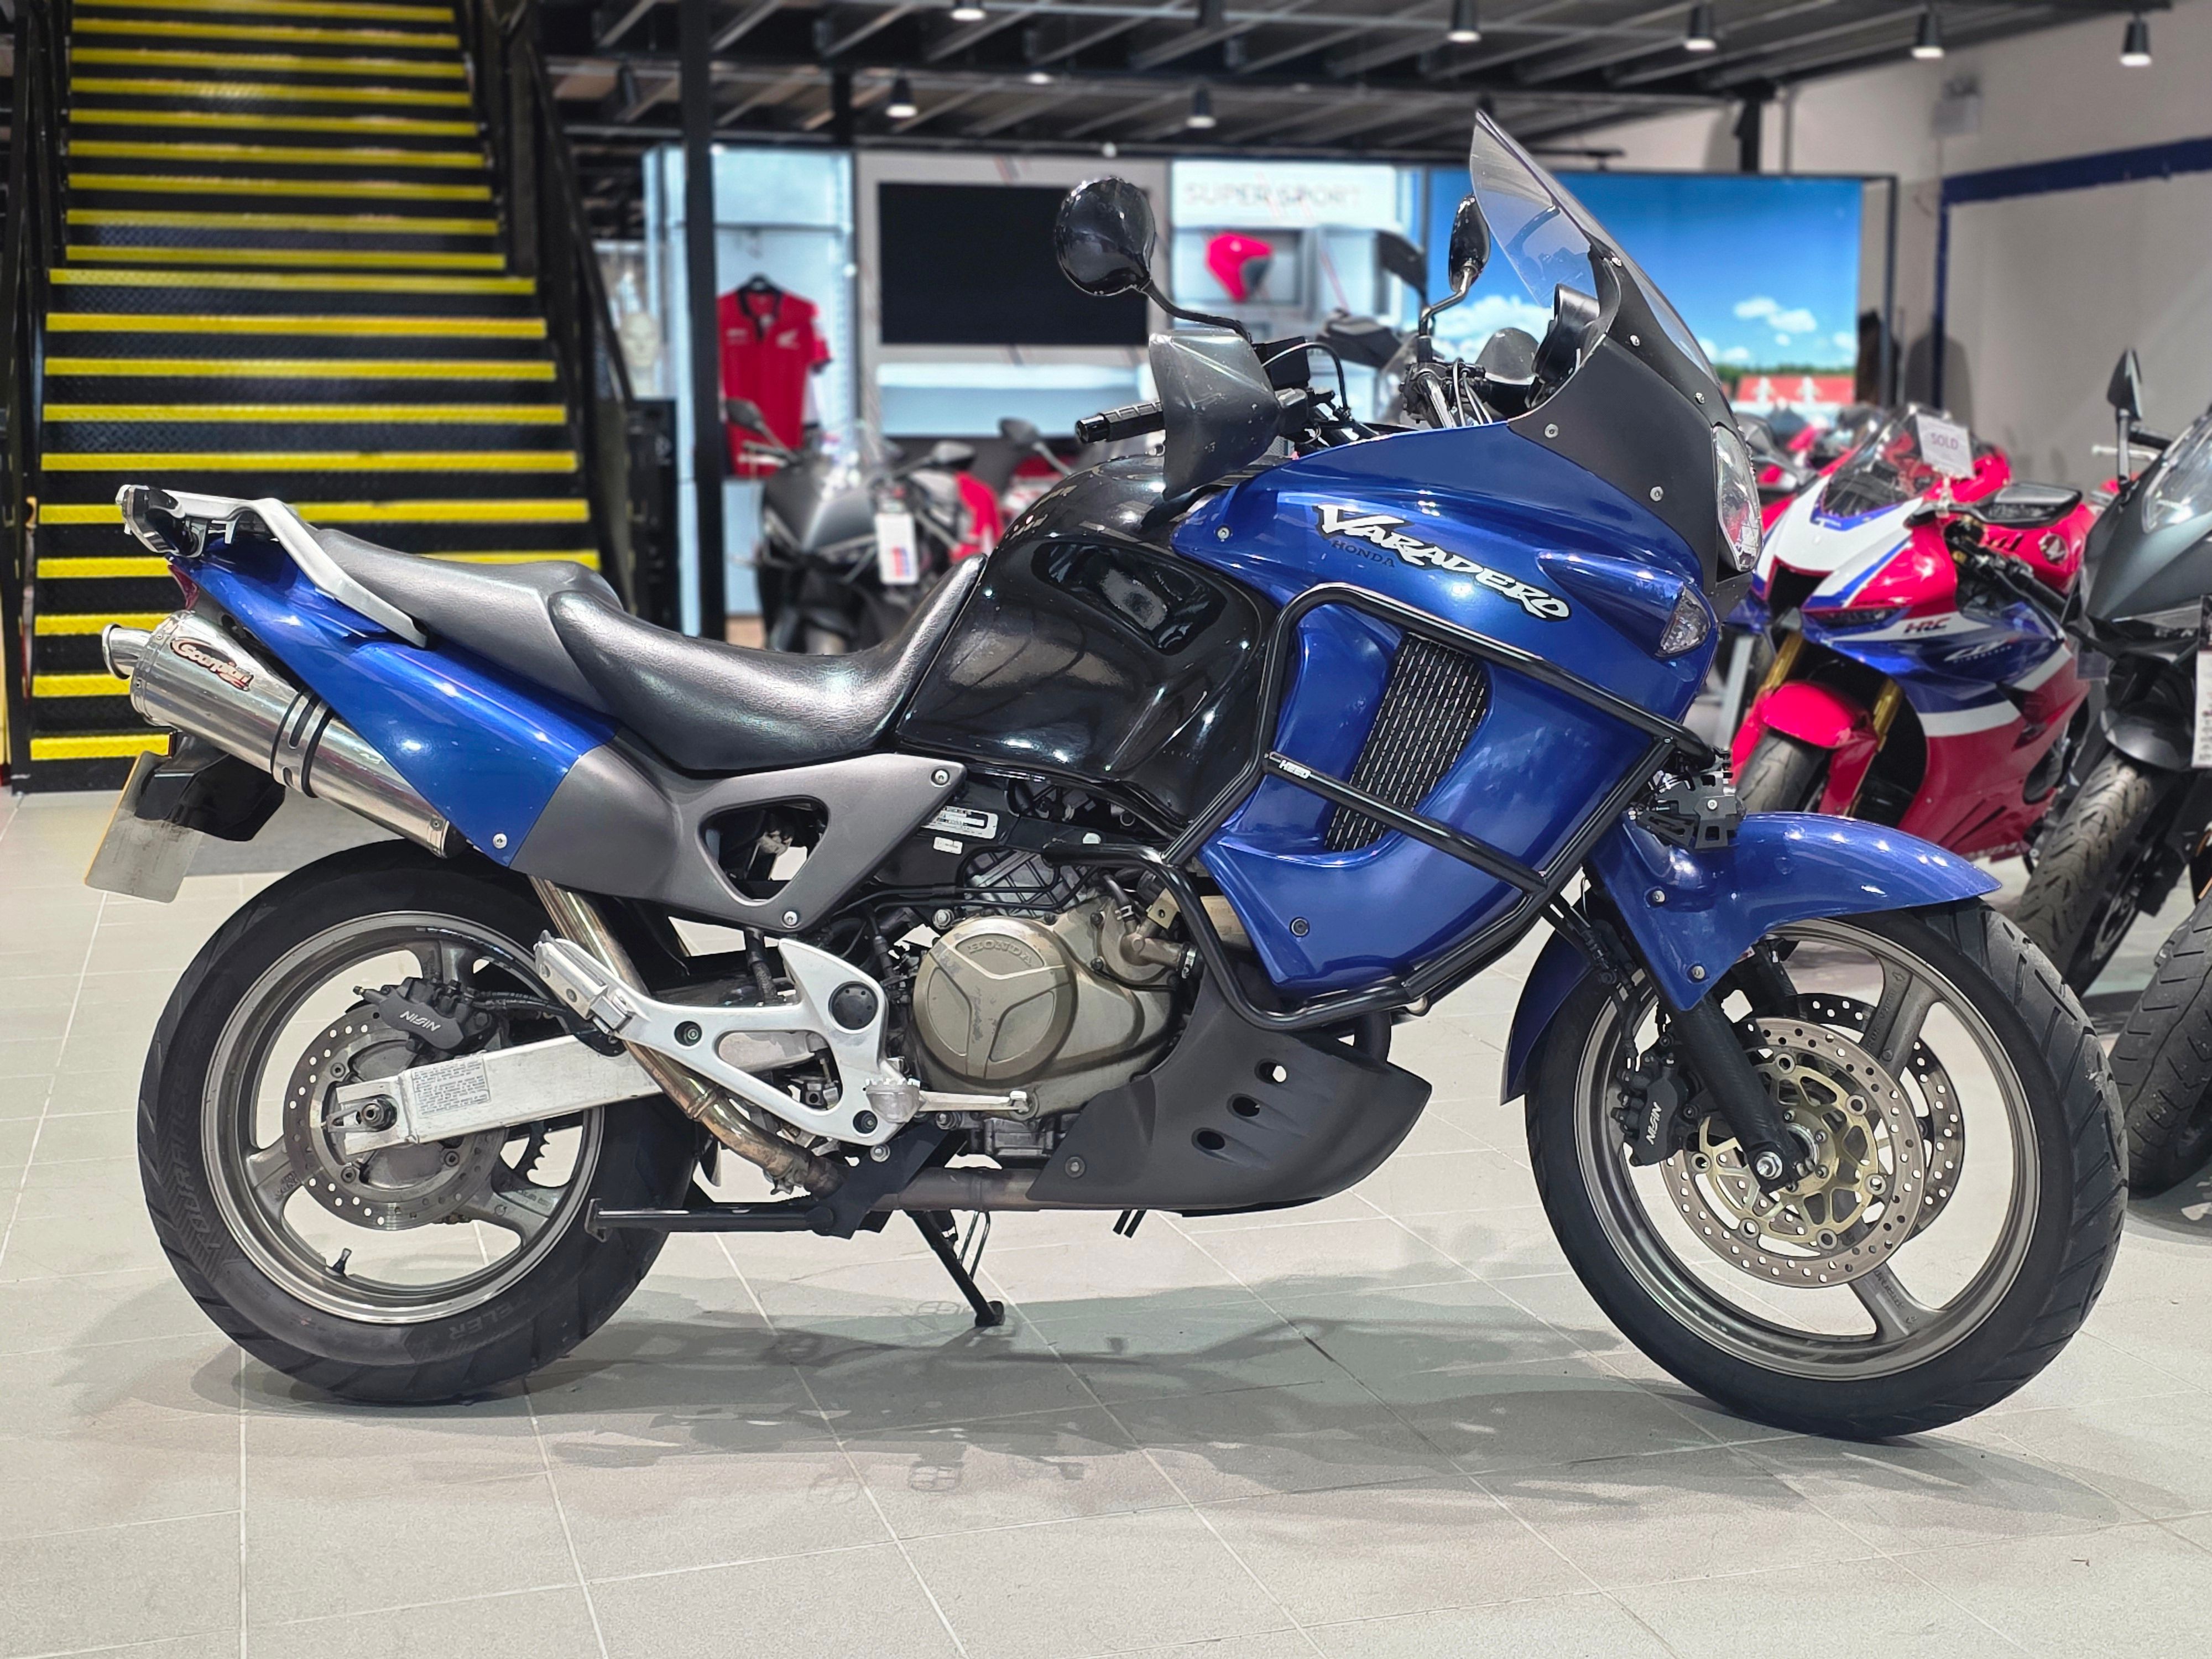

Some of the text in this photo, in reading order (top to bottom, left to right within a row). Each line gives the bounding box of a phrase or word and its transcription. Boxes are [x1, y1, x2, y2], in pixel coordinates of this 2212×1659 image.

[1930, 433, 1959, 450] SOLD
[1316, 503, 1571, 619] VARADERO
[1331, 540, 1395, 568] HONDA
[1904, 617, 1952, 634] HRC
[967, 939, 1033, 967] HONDA
